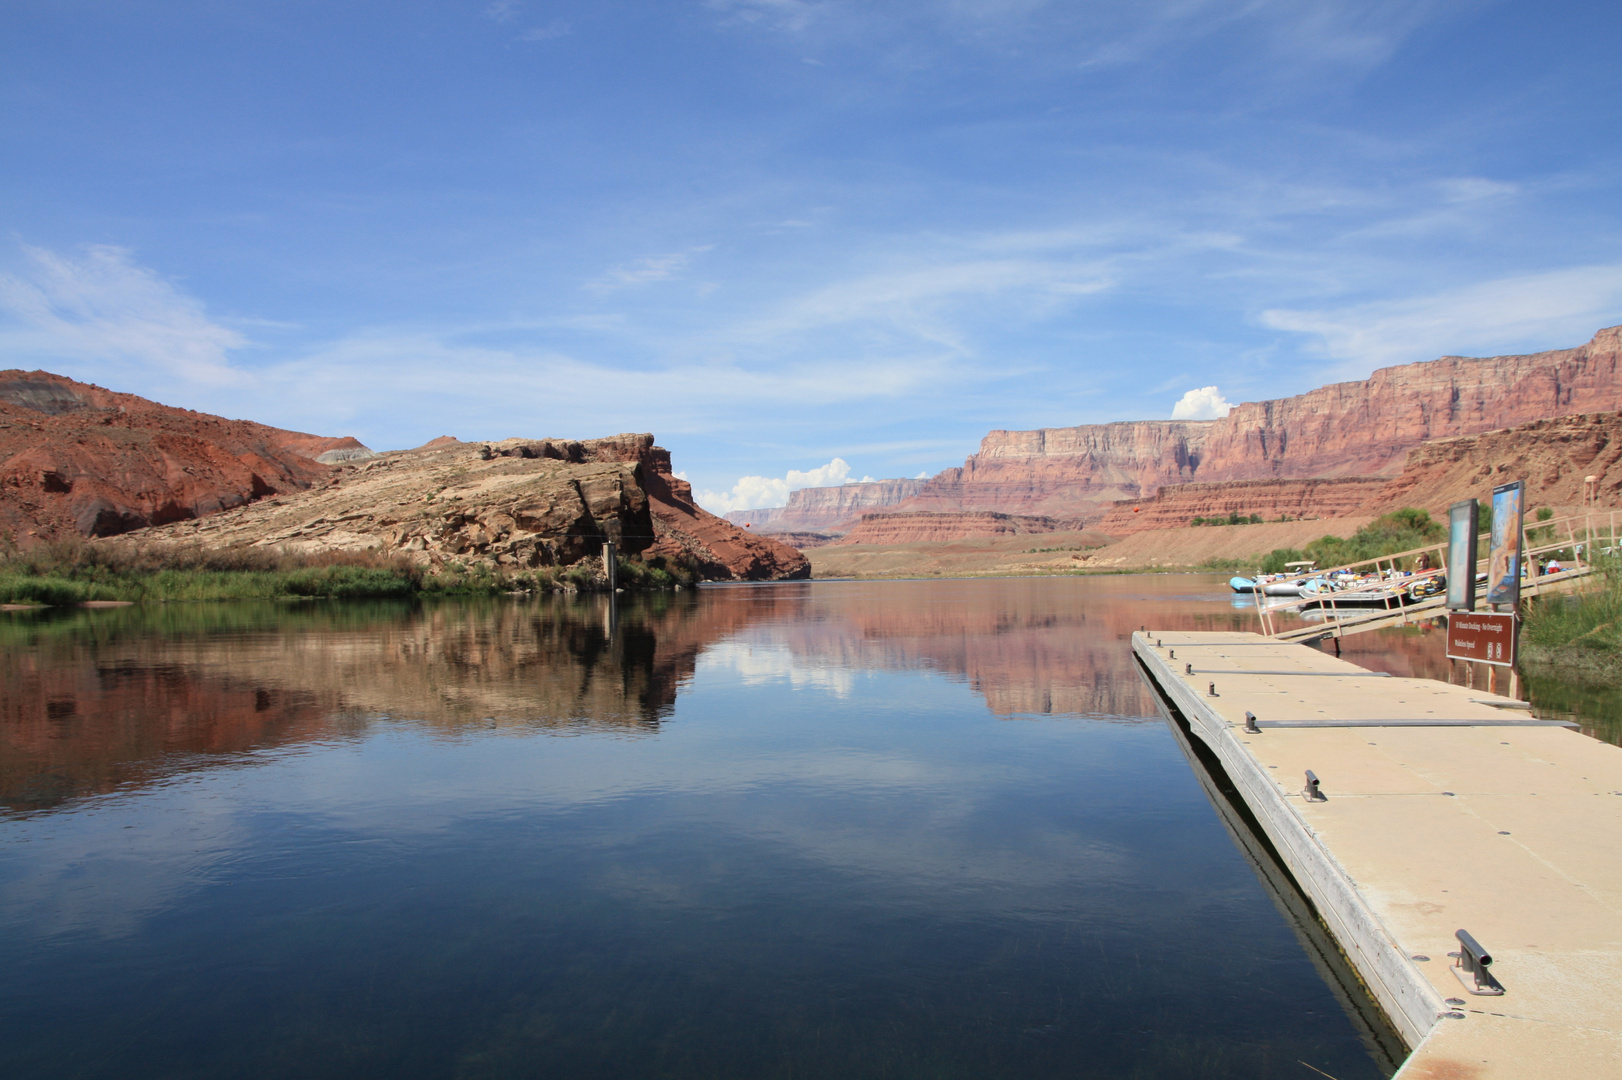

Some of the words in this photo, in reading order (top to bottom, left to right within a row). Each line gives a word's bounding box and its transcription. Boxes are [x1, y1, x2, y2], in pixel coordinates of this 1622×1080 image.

[1459, 621, 1468, 629] Minute
[1468, 622, 1480, 632] Docking
[1487, 623, 1502, 633] Overnight
[1454, 639, 1466, 648] Wakeless
[1466, 640, 1475, 650] Speed
